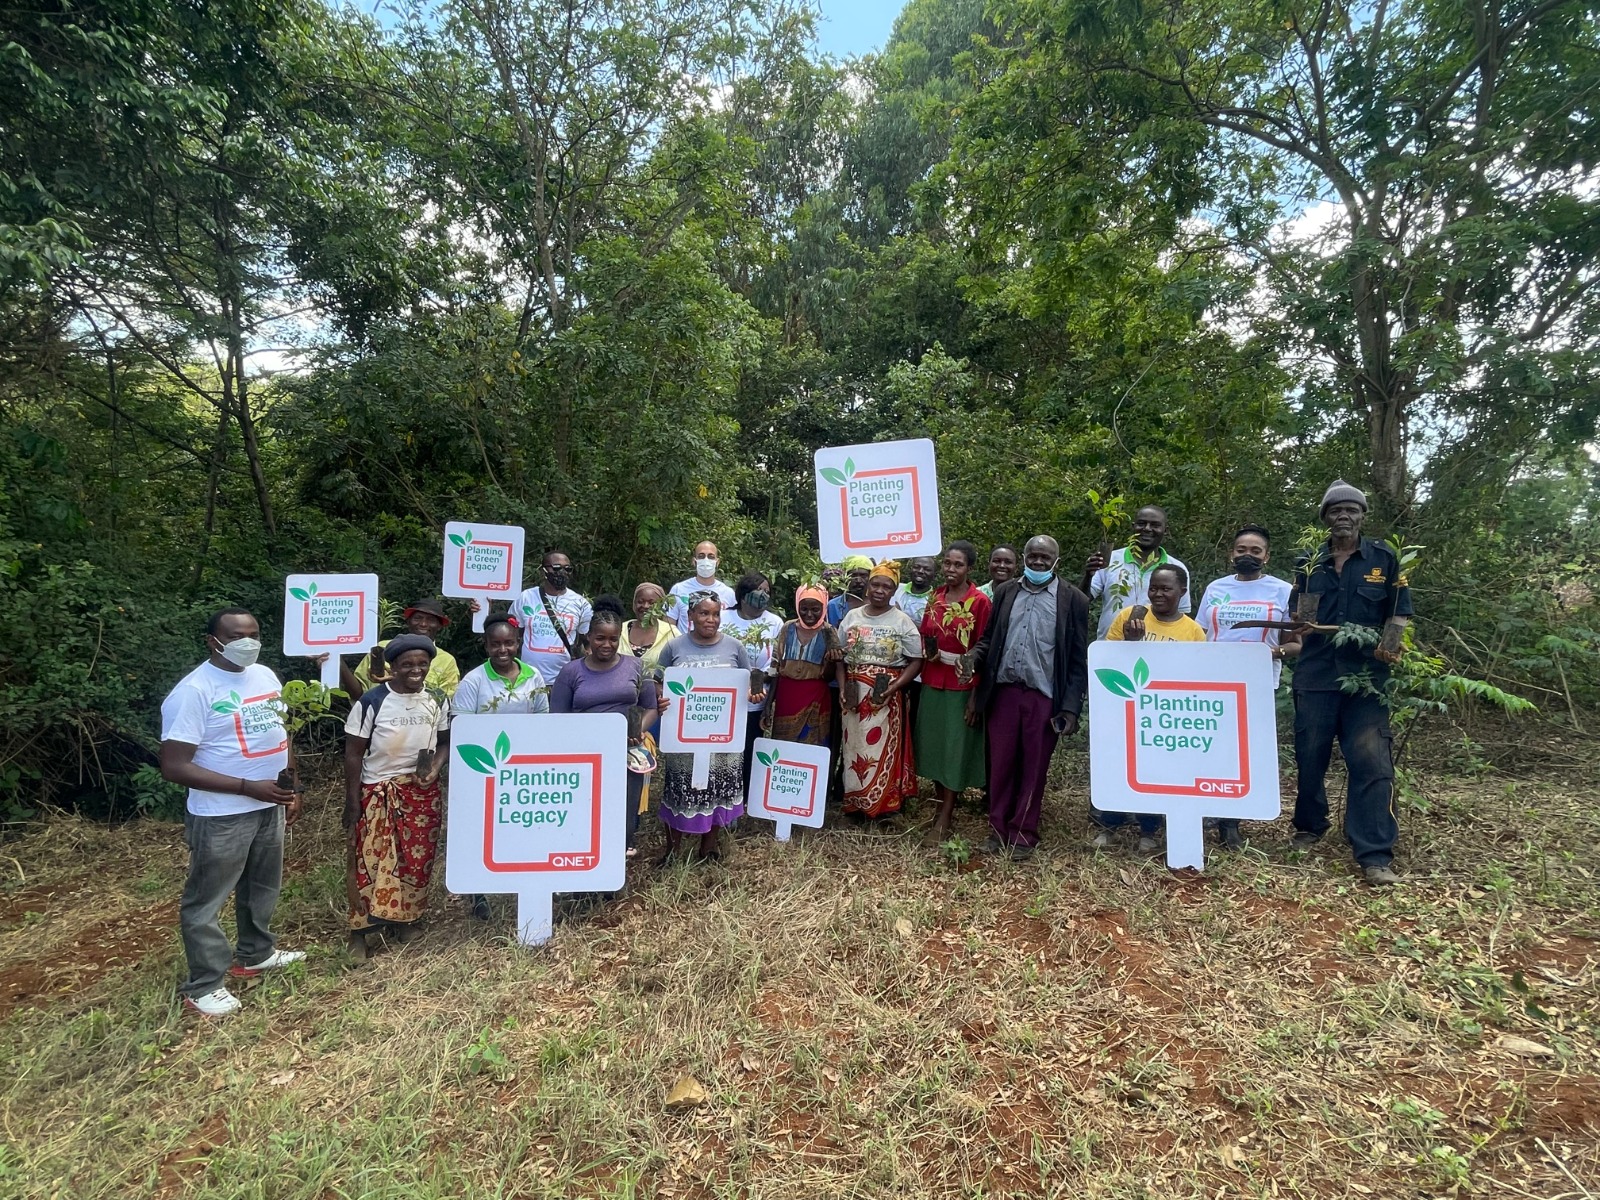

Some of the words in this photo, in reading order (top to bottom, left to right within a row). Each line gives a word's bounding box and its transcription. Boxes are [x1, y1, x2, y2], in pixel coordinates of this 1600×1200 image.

[849, 478, 904, 492] Planting
[851, 496, 858, 505] a
[862, 492, 900, 504] Green
[851, 505, 898, 518] Legacy
[890, 533, 919, 542] QNET
[467, 546, 503, 557] Planting
[474, 555, 500, 563] Green
[466, 562, 497, 572] Legacy
[311, 598, 354, 607] Planting
[311, 617, 347, 626] Legacy
[687, 694, 726, 705] Planting
[1140, 694, 1224, 716] Planting
[245, 718, 251, 726] a
[686, 712, 719, 722] Legacy
[1140, 716, 1152, 728] a
[1158, 713, 1218, 731] Green
[1141, 730, 1213, 753] Legacy
[500, 768, 580, 789] Planting
[773, 765, 808, 780] Planting
[780, 775, 804, 787] Green
[771, 783, 801, 796] Legacy
[1199, 782, 1245, 794] QNET
[499, 793, 510, 805] a
[517, 788, 573, 805] Green
[791, 807, 812, 816] QNET
[499, 808, 568, 828] Legacy
[552, 856, 595, 867] QNET
